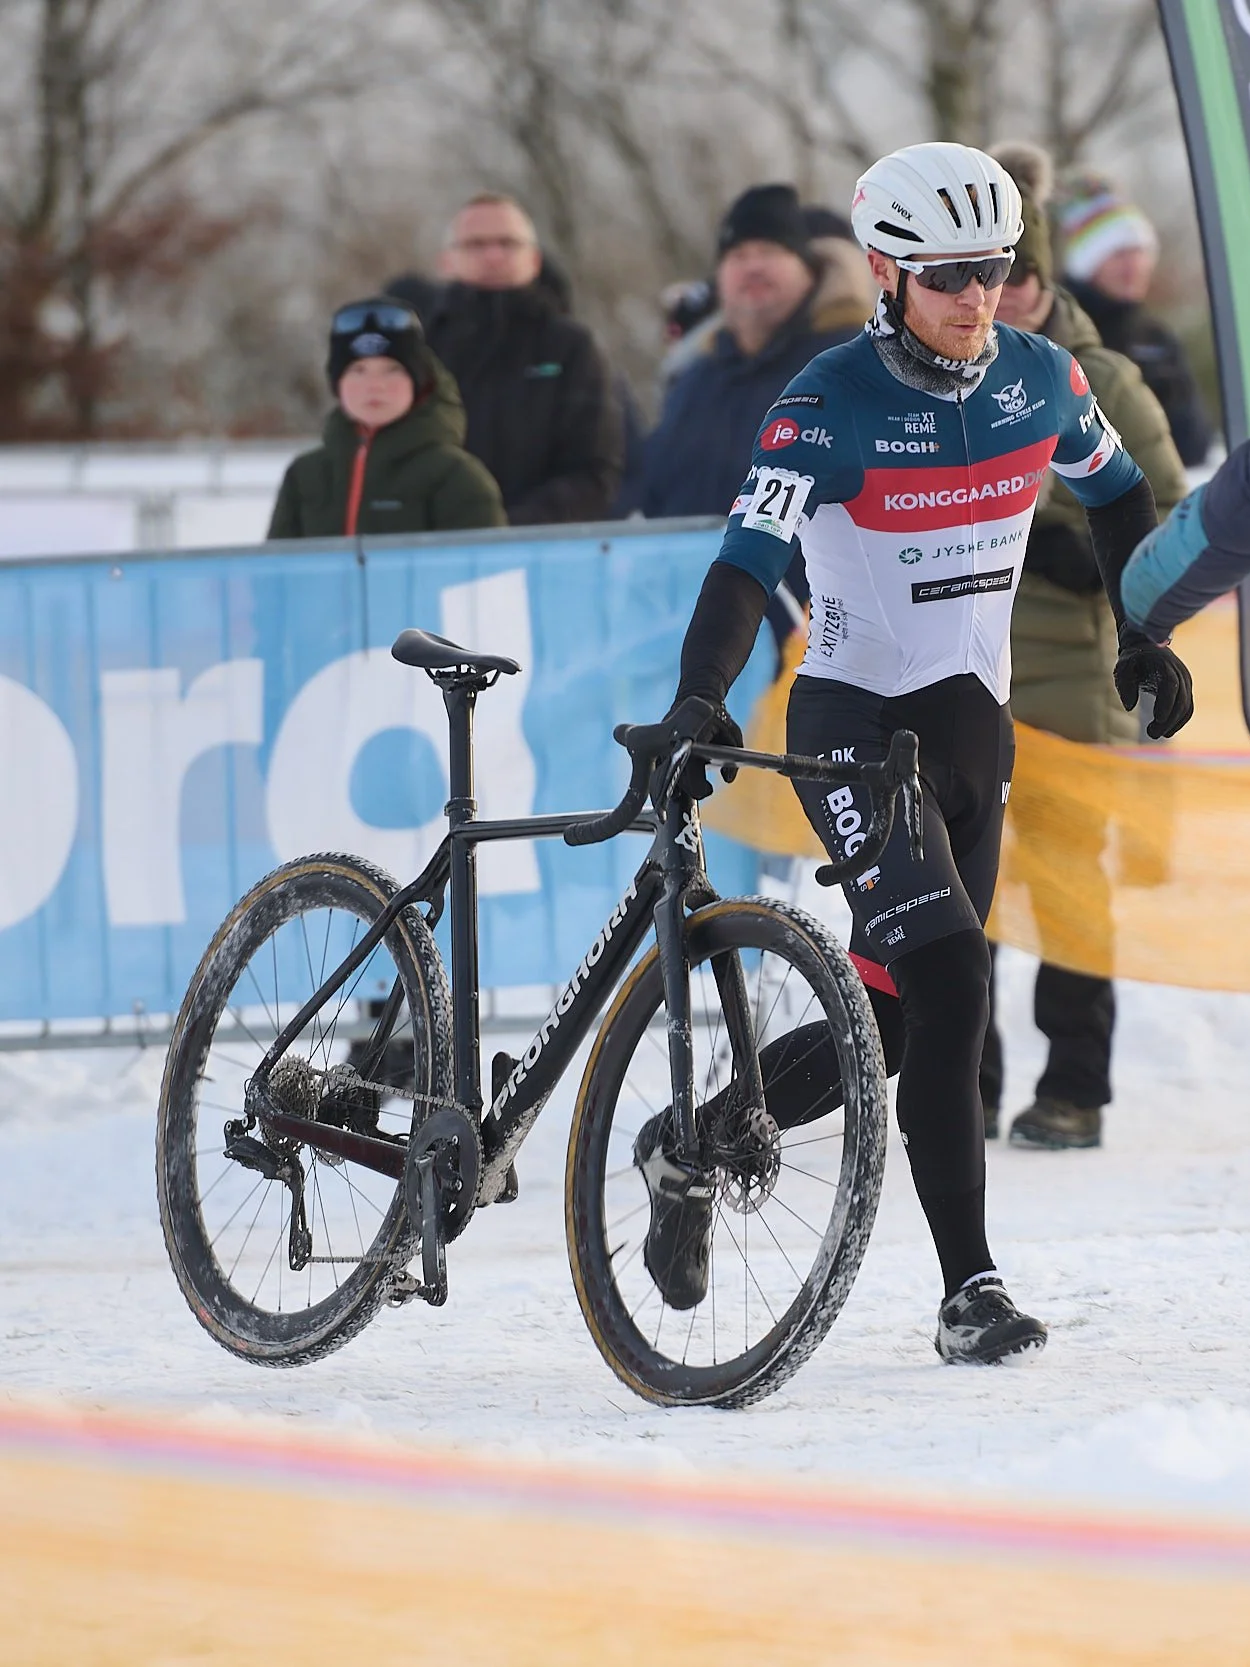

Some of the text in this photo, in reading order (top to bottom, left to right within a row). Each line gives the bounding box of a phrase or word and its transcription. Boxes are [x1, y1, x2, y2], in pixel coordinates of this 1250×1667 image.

[891, 201, 913, 222] uvex
[904, 422, 937, 434] REME
[921, 411, 935, 423] XT
[772, 424, 834, 449] je.dk
[756, 478, 797, 522] 21
[932, 527, 1025, 559] JYSKE BANK
[918, 572, 1012, 597] ceramicspeed
